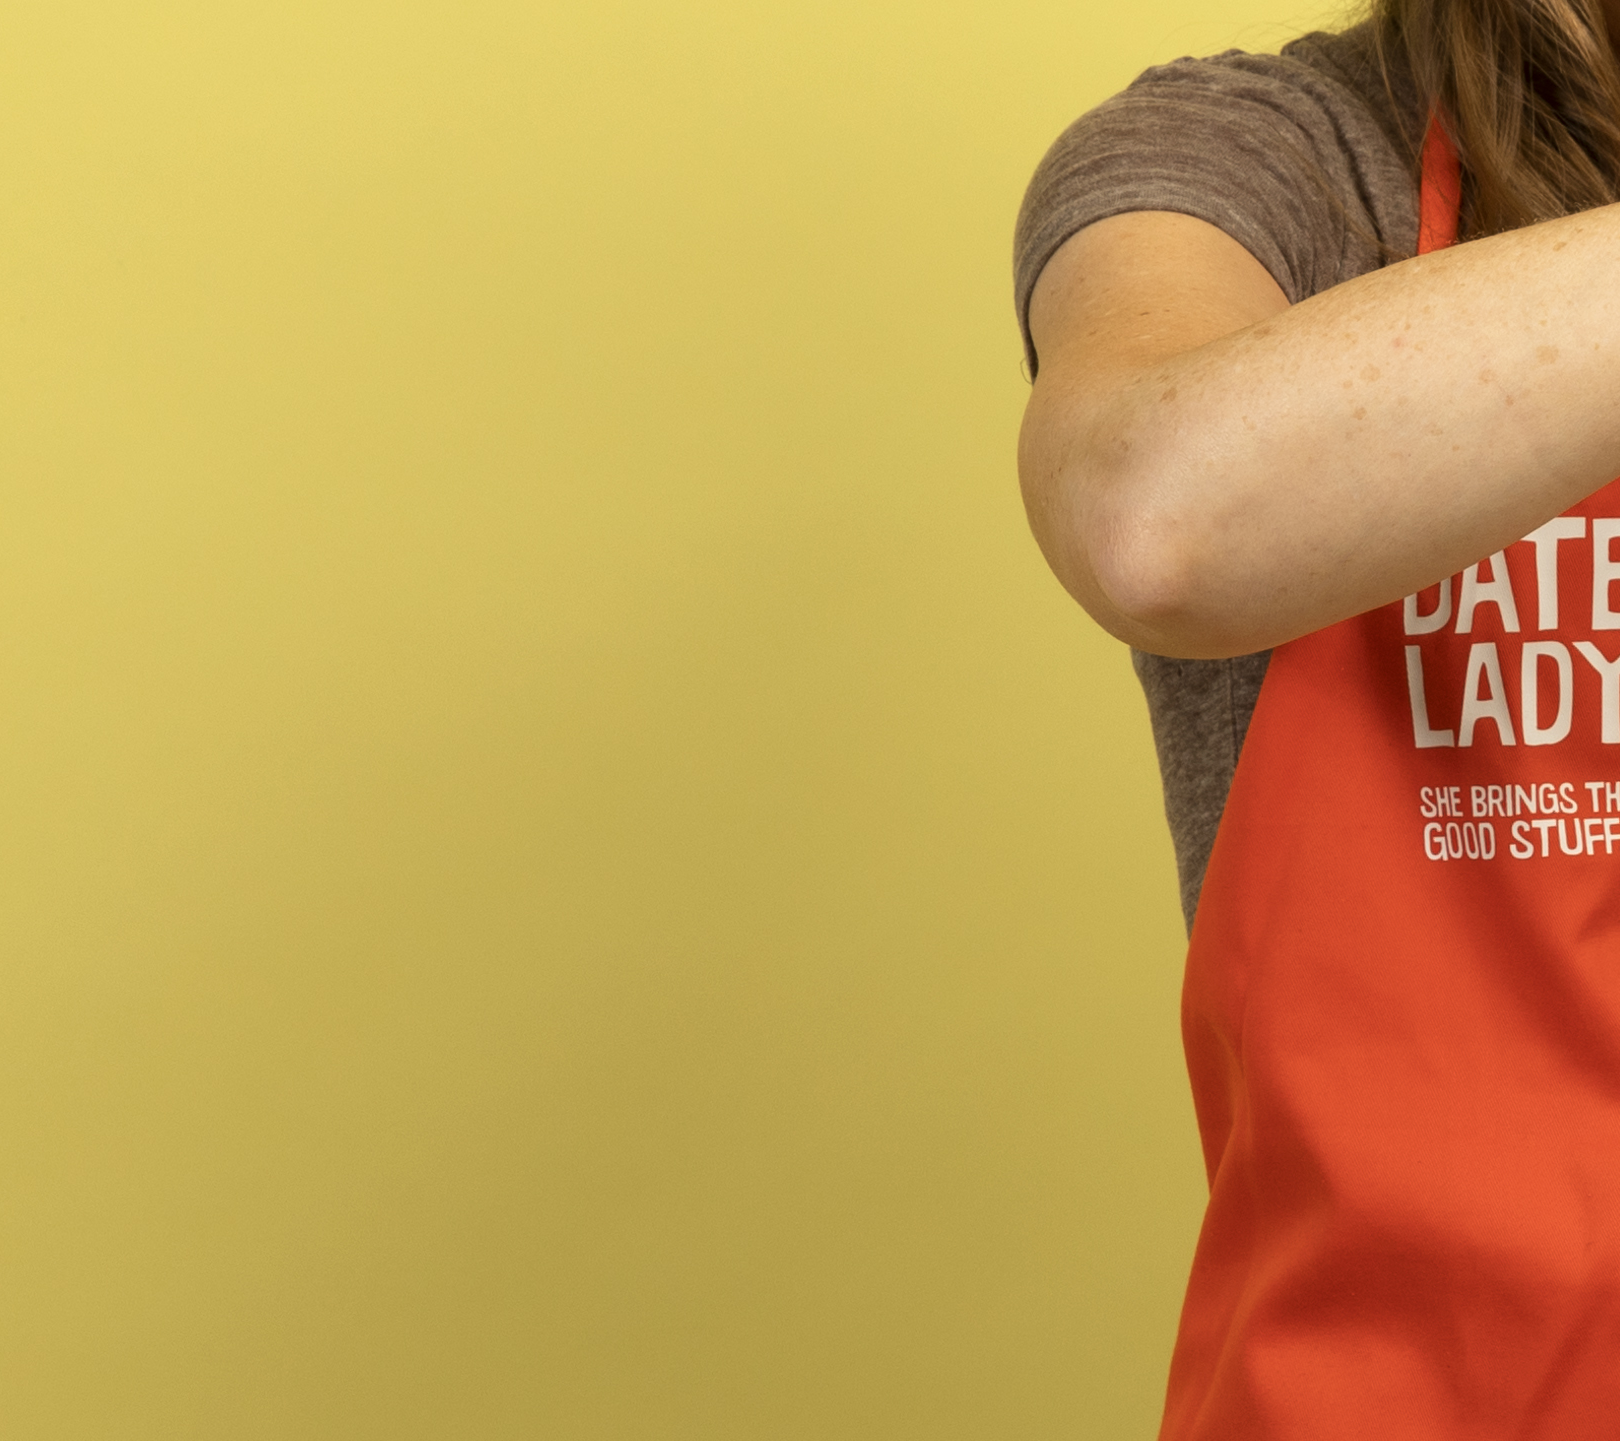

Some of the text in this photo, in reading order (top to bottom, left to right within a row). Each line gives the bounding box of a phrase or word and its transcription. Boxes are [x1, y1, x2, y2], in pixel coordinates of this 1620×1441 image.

[1420, 787, 1463, 817] SHE
[1471, 783, 1578, 817] BRINGS
[1424, 822, 1495, 860] GOOD
